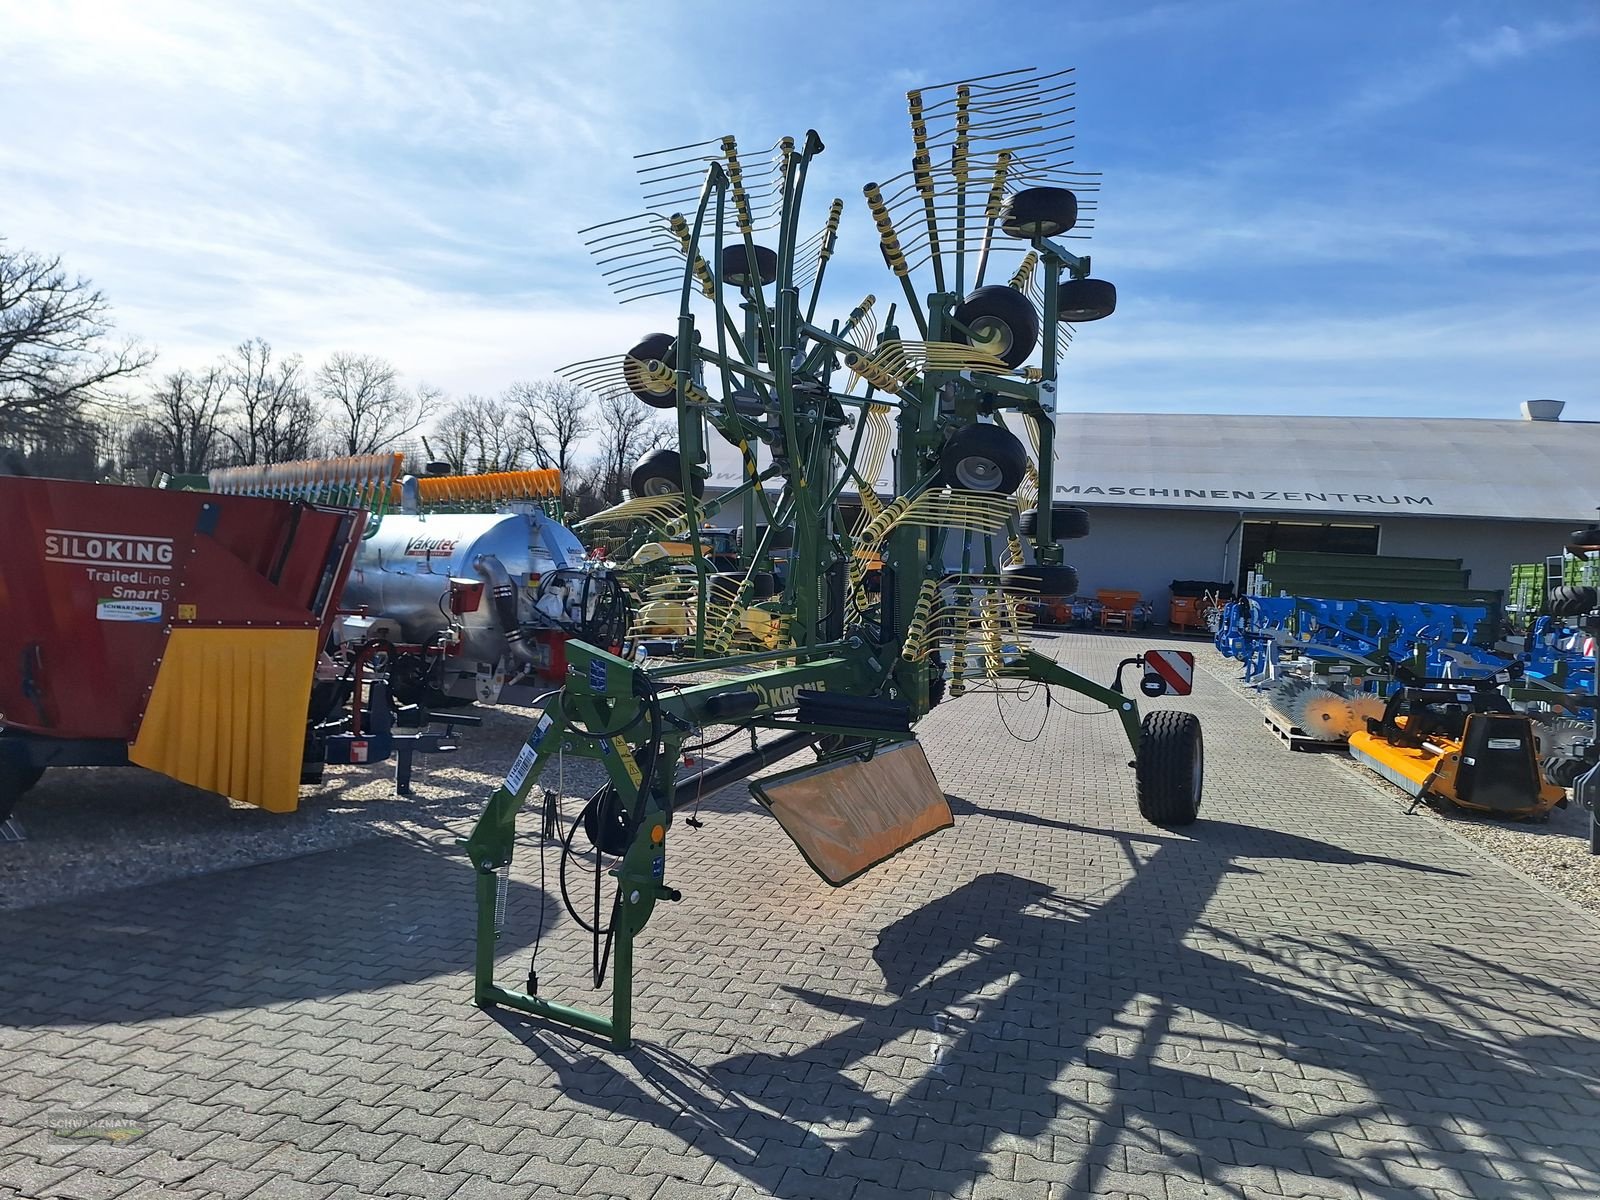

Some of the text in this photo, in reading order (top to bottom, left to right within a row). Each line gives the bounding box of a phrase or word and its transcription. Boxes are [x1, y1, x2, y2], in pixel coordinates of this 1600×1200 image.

[1055, 484, 1434, 506] MASCHINENZENTRUM
[45, 536, 173, 562] SILOKING
[404, 534, 459, 556] Vakutec
[86, 568, 171, 586] TrailedLine
[112, 586, 170, 601] Smart 5
